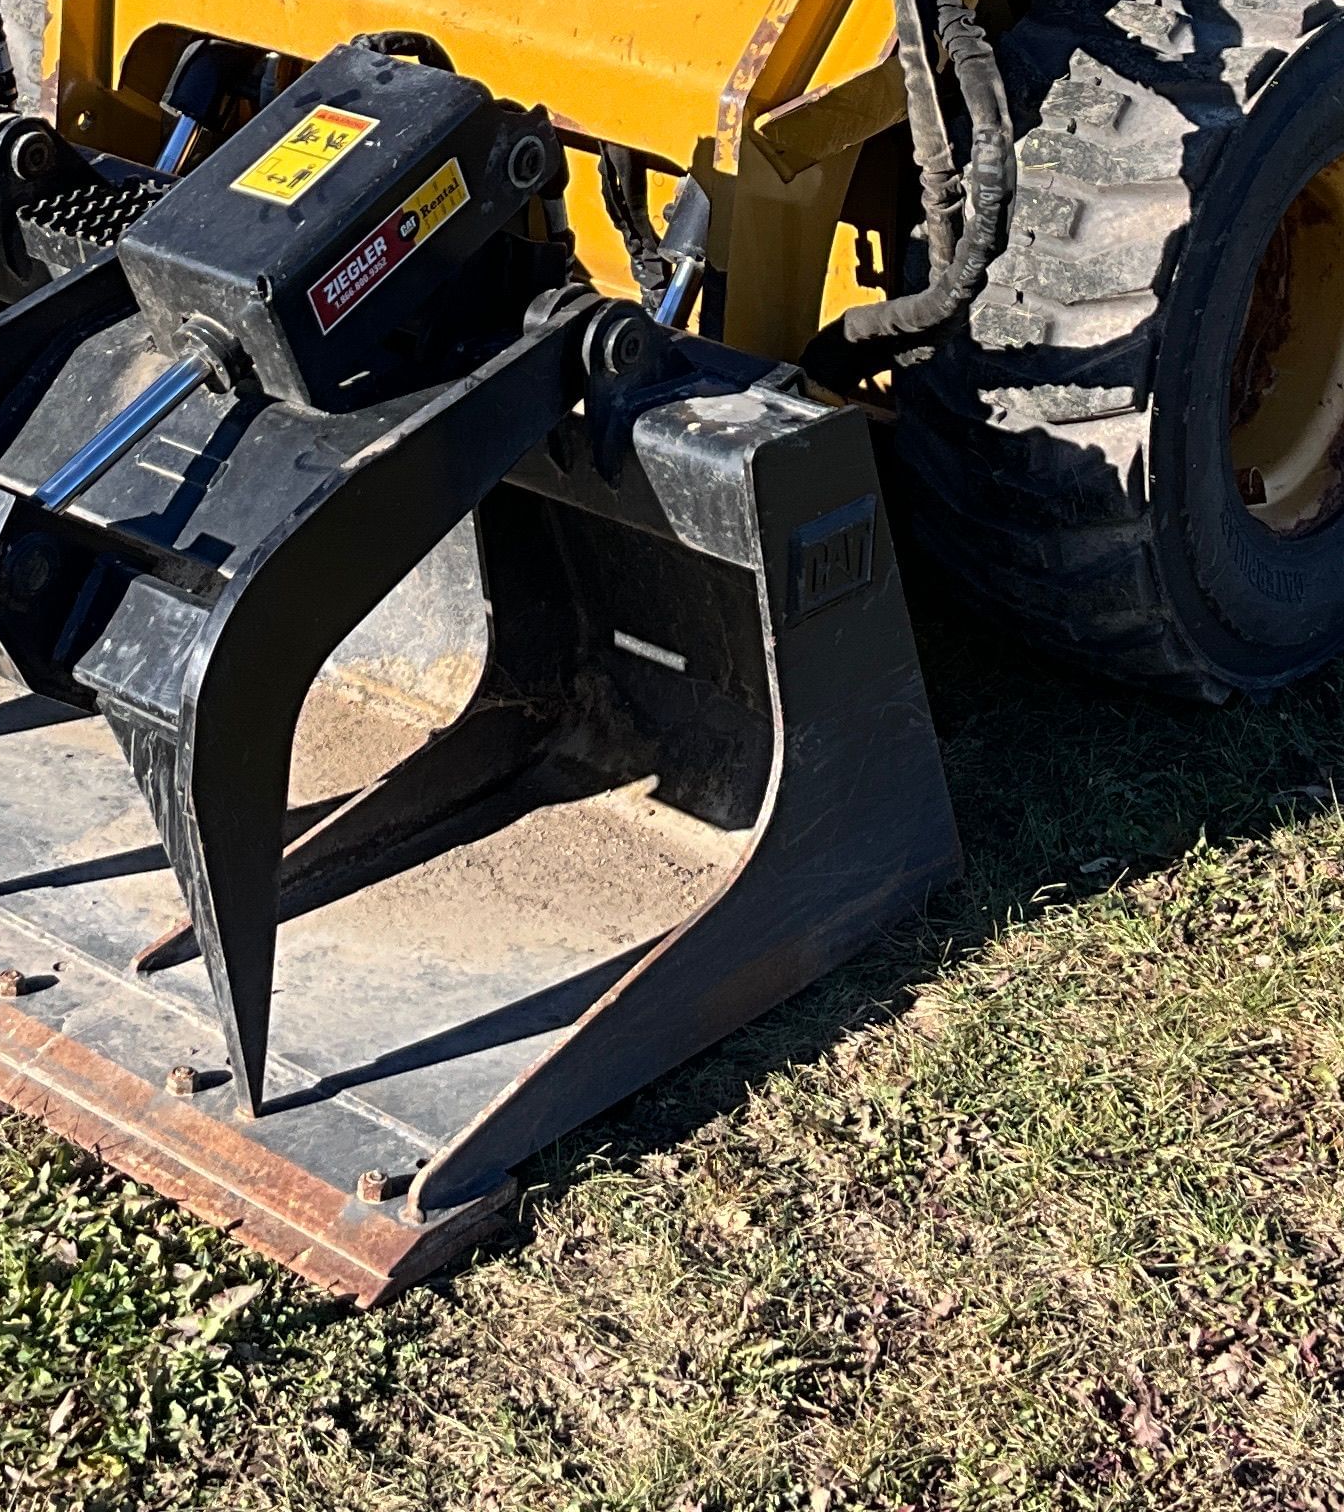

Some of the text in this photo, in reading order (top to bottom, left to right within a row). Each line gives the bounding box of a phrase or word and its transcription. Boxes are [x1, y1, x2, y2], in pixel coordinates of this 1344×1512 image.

[400, 214, 417, 238] CAT
[419, 176, 460, 219] Rental
[323, 235, 388, 304] ZIEGLER
